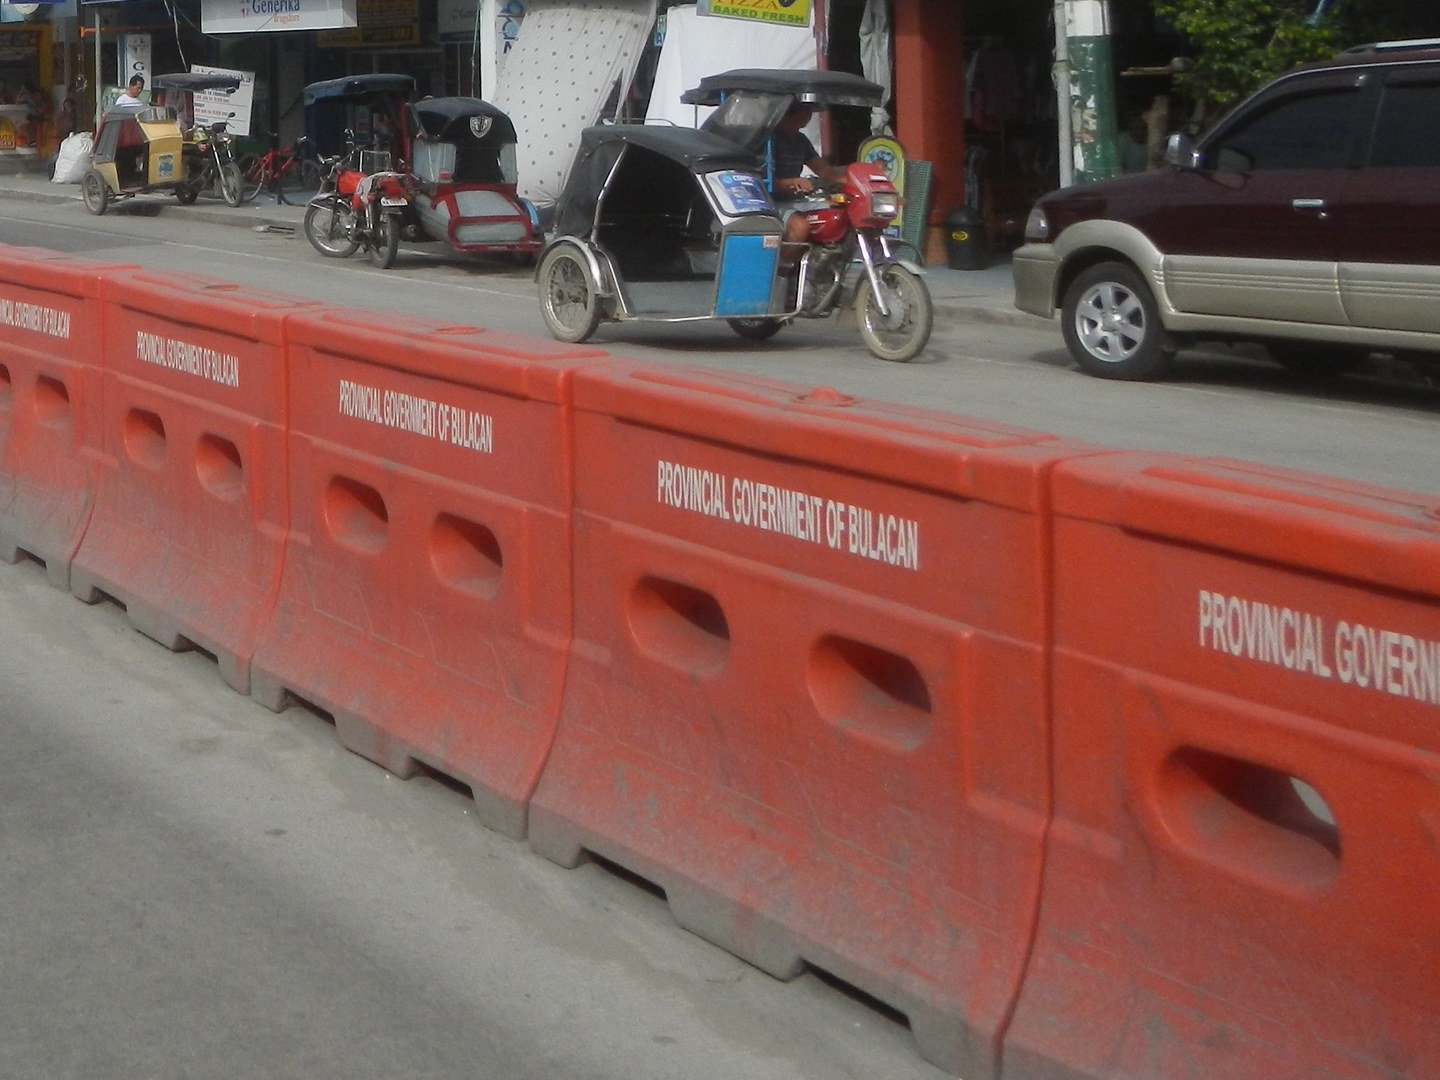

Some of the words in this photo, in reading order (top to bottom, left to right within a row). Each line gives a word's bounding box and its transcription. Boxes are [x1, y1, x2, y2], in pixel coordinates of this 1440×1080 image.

[712, 5, 758, 18] BAKED
[761, 12, 804, 23] FRESH
[137, 330, 167, 367] PROVINCIAL
[167, 338, 203, 377] GOVERNMENT
[203, 347, 211, 379] OF
[211, 350, 239, 388] BULACAN
[339, 380, 382, 424] PROVINCIAL
[384, 390, 437, 438] GOVERNMENT
[438, 403, 449, 441] OF
[451, 406, 493, 454] BULACAN
[657, 460, 729, 520] PROVINCIAL
[732, 477, 823, 544] GOVERNMENT
[826, 499, 845, 550] OF
[848, 505, 919, 571] BULACAN
[1198, 589, 1332, 678] PROVINCIAL
